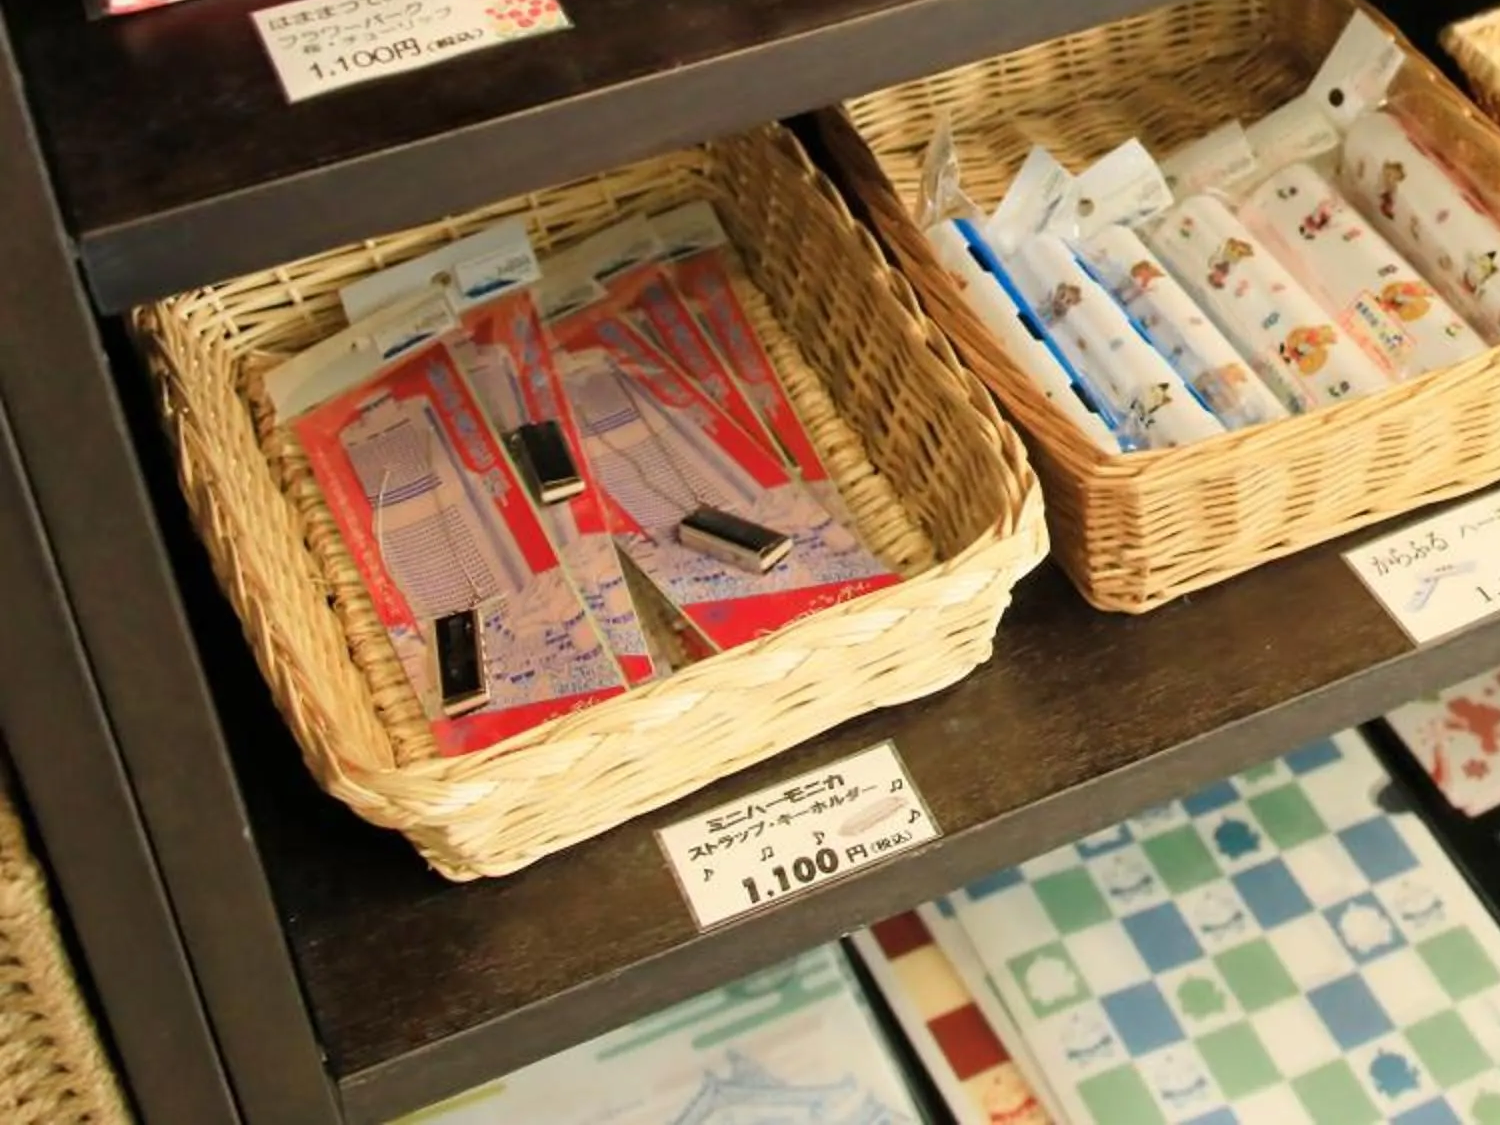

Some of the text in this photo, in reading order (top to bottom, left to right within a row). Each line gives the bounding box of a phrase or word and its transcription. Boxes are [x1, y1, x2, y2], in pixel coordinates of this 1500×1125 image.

[1369, 531, 1450, 578] からふる
[705, 773, 845, 834] ミニハーモニカ
